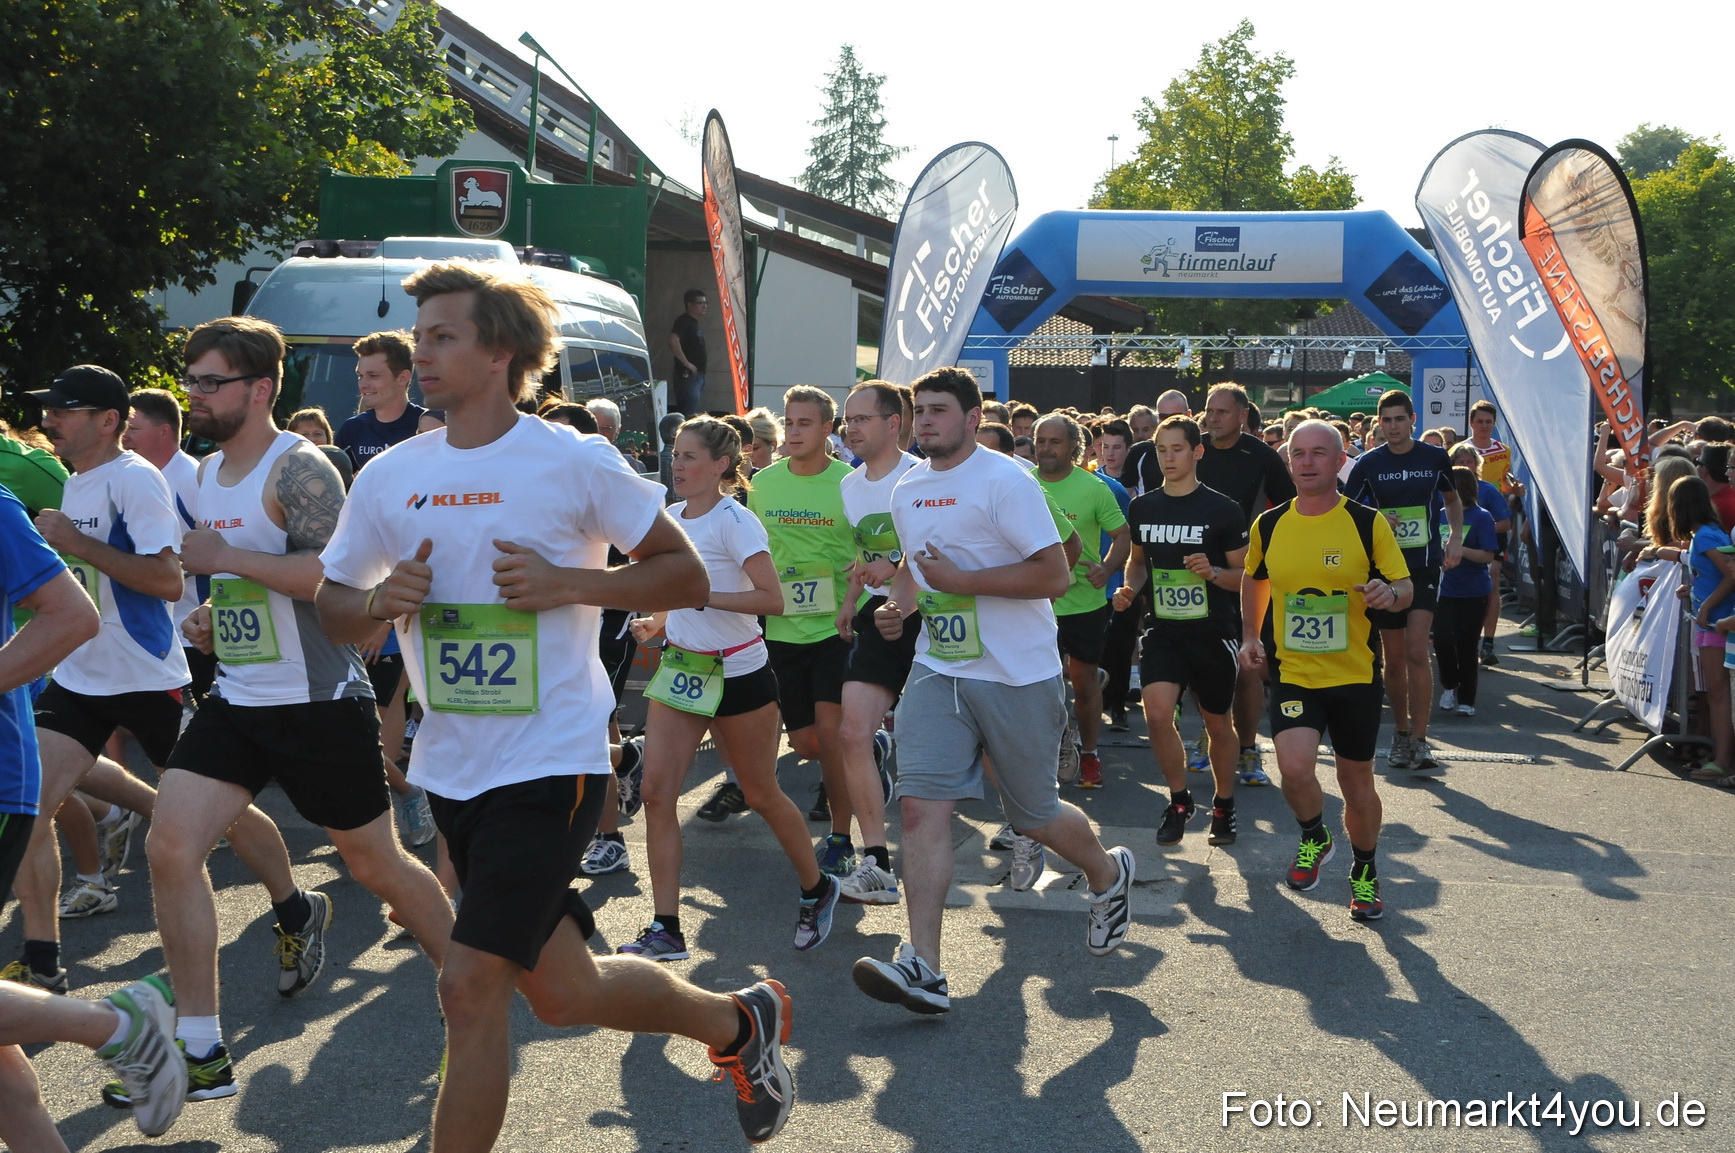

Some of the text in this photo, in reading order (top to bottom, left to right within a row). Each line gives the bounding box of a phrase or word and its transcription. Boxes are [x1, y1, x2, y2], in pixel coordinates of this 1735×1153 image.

[468, 221, 493, 231] 1628
[1204, 235, 1237, 243] Fischer
[916, 178, 987, 334] Fischer
[1179, 253, 1277, 271] firmenlauf
[942, 208, 998, 333] AUTOMOBILE
[991, 283, 1044, 295] Fischer
[359, 445, 384, 455] EURO
[1378, 470, 1433, 481] EURO POLES
[432, 492, 504, 506] KLEBL
[924, 498, 957, 507] KLEBL
[765, 509, 821, 518] autoladen
[214, 518, 244, 529] KLEBL
[778, 517, 834, 526] neumarkt
[1139, 524, 1204, 544] THULE
[1325, 555, 1339, 565] FC
[791, 581, 818, 604] 37
[1155, 586, 1205, 607] 1396
[217, 608, 261, 643] 539
[926, 615, 966, 643] 520
[1291, 615, 1334, 640] 231
[440, 642, 517, 686] 542
[669, 672, 703, 699] 98
[464, 698, 490, 706] Dynamics
